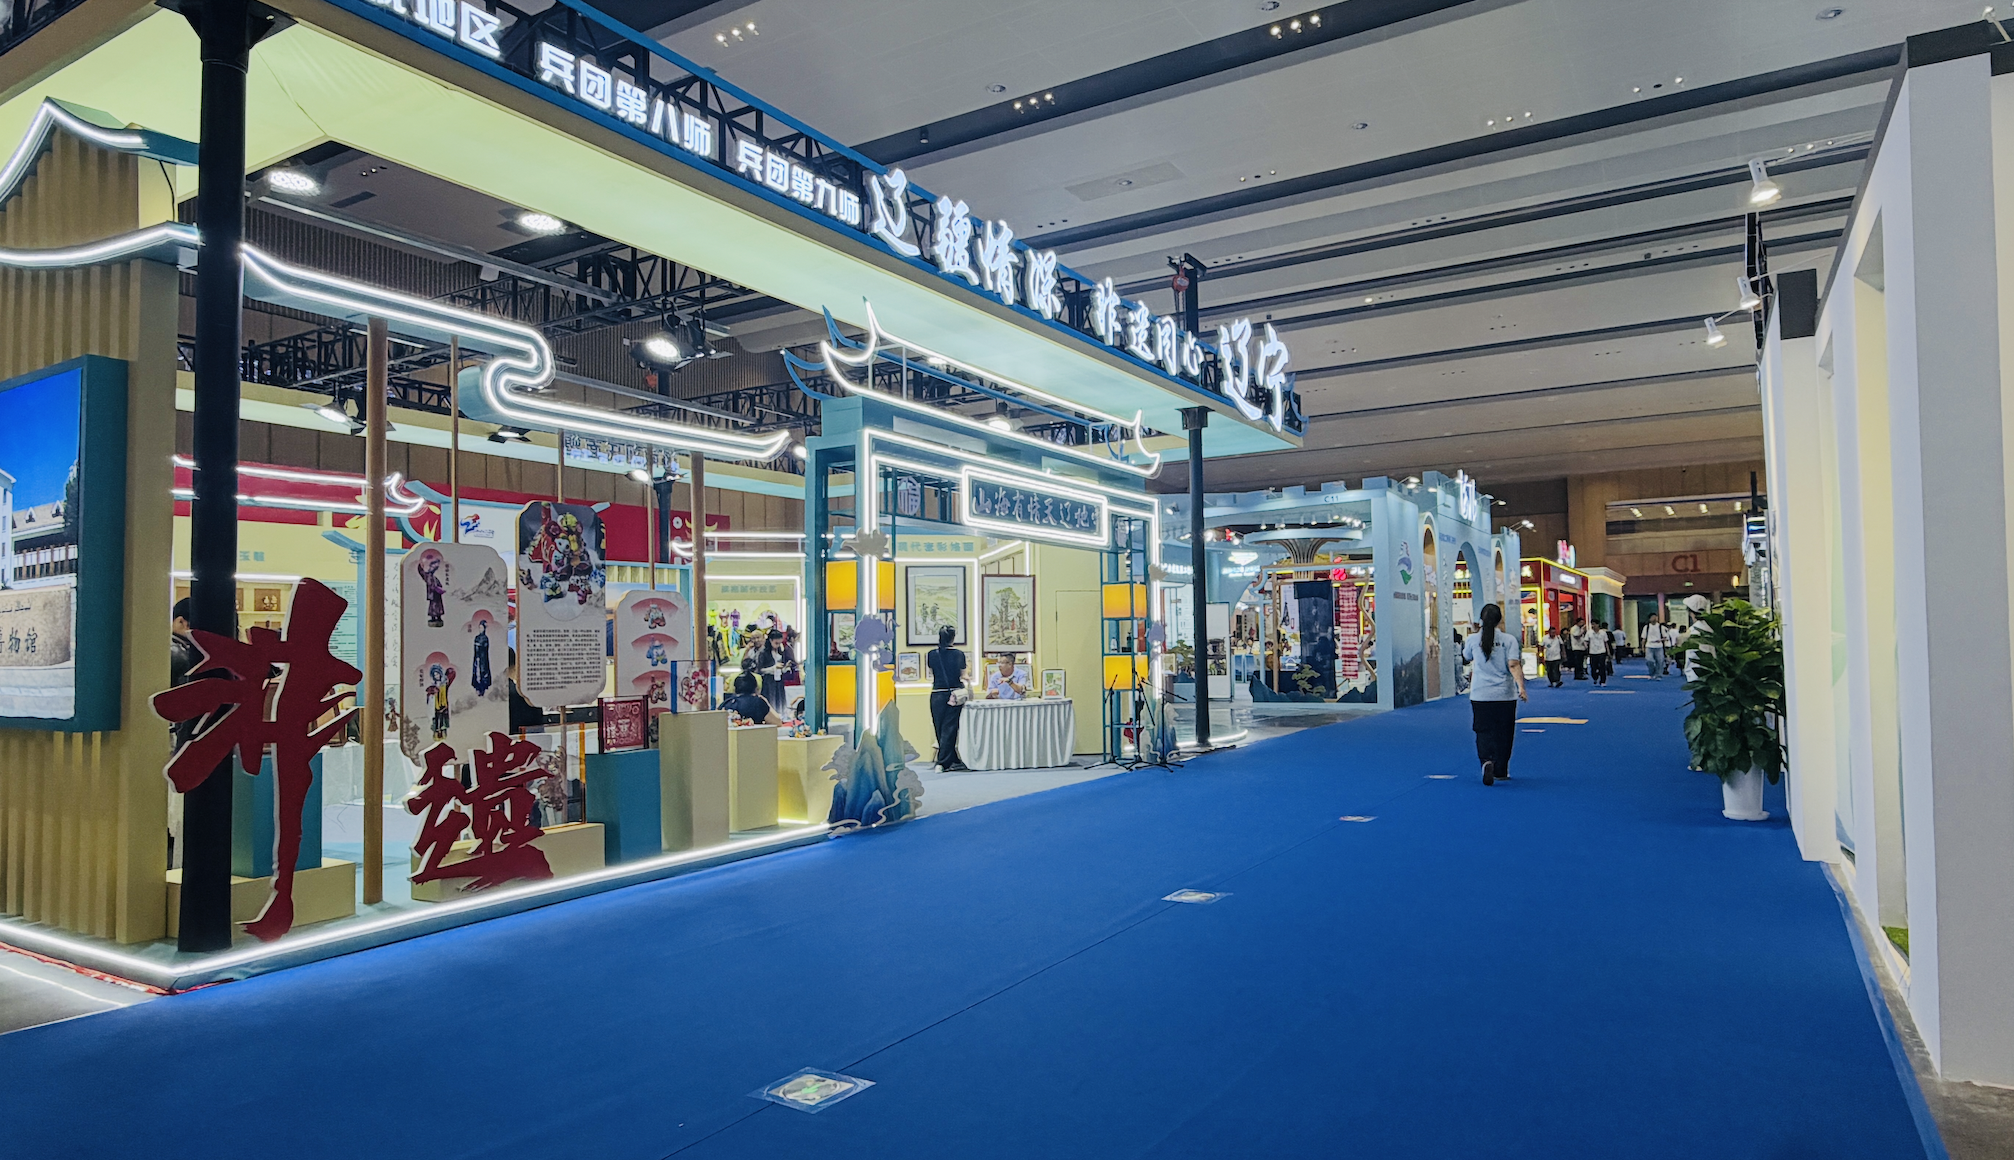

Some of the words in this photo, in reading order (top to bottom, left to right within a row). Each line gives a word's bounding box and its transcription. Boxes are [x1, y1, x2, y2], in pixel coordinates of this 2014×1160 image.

[369, 0, 502, 58] 地区
[537, 42, 713, 157] 兵团第八师
[737, 140, 861, 226] 兵团第九师
[1218, 318, 1290, 433] 辽宁
[1324, 495, 1339, 503] C11
[1671, 554, 1701, 573] C1
